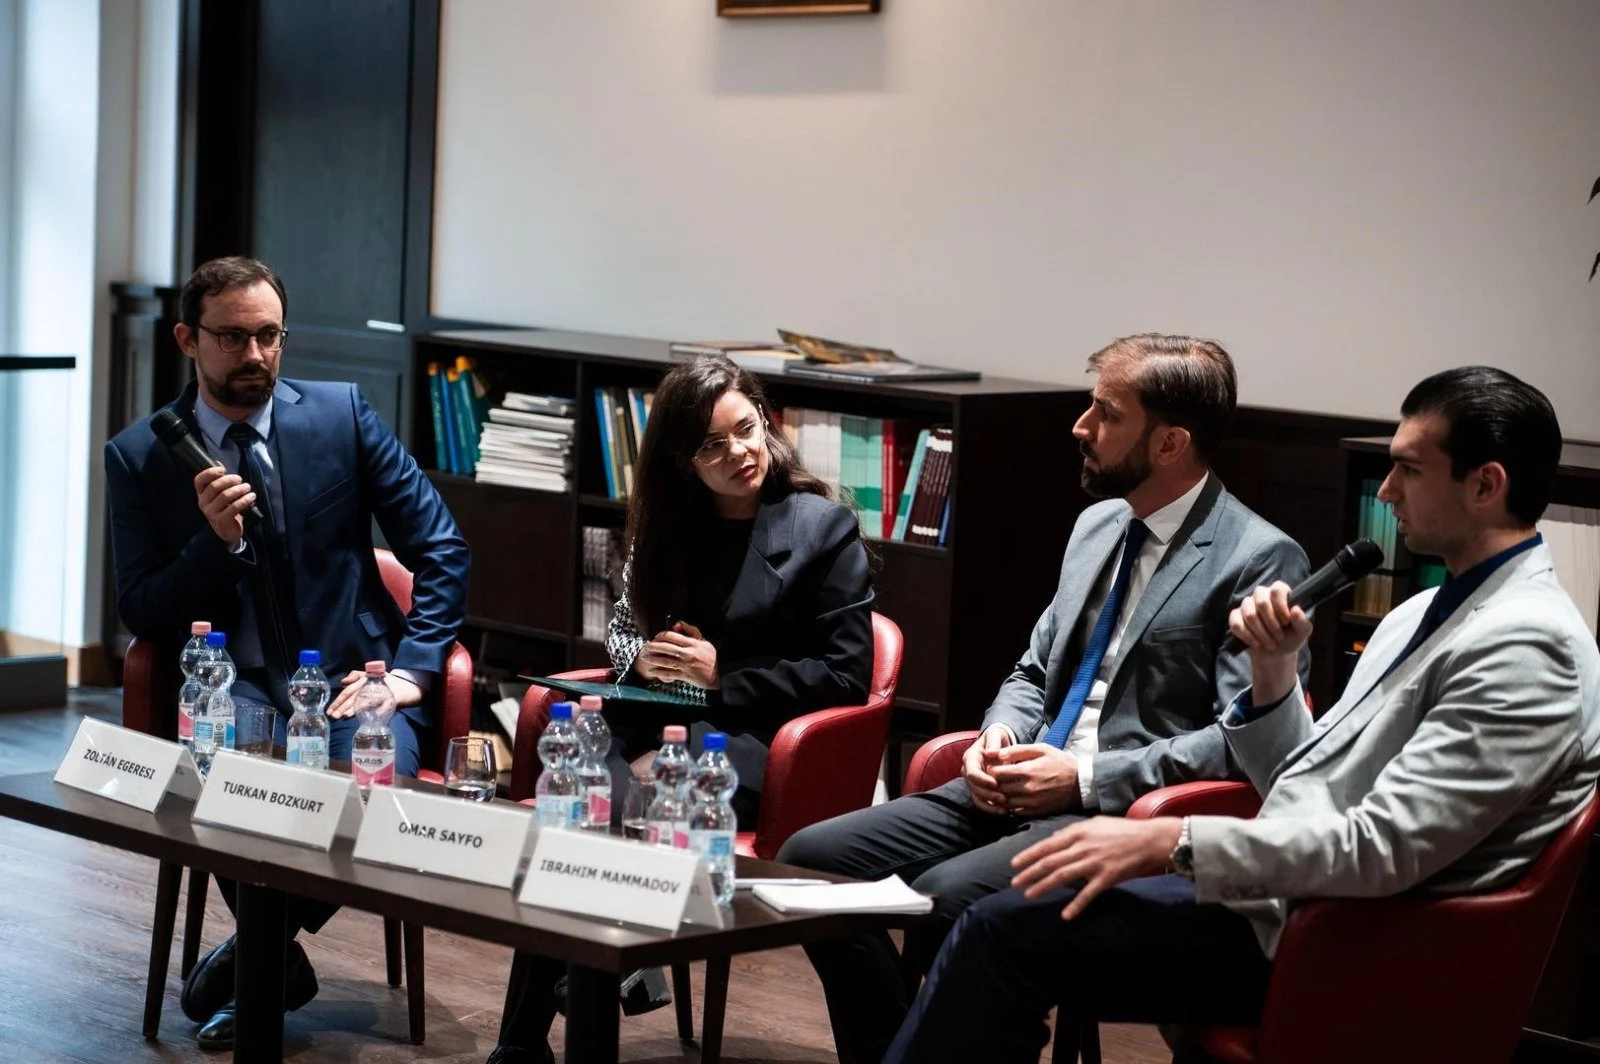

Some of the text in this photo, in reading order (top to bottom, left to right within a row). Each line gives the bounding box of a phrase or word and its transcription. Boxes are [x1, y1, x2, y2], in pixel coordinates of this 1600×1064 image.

[84, 749, 117, 767] ZOLTÁN
[117, 759, 156, 780] EGERESI
[223, 781, 324, 813] TURKAN BOZKURT
[398, 822, 483, 848] OMAR SAYFO
[540, 859, 597, 879] IBRAHIM
[600, 870, 681, 894] MAMMADOV
